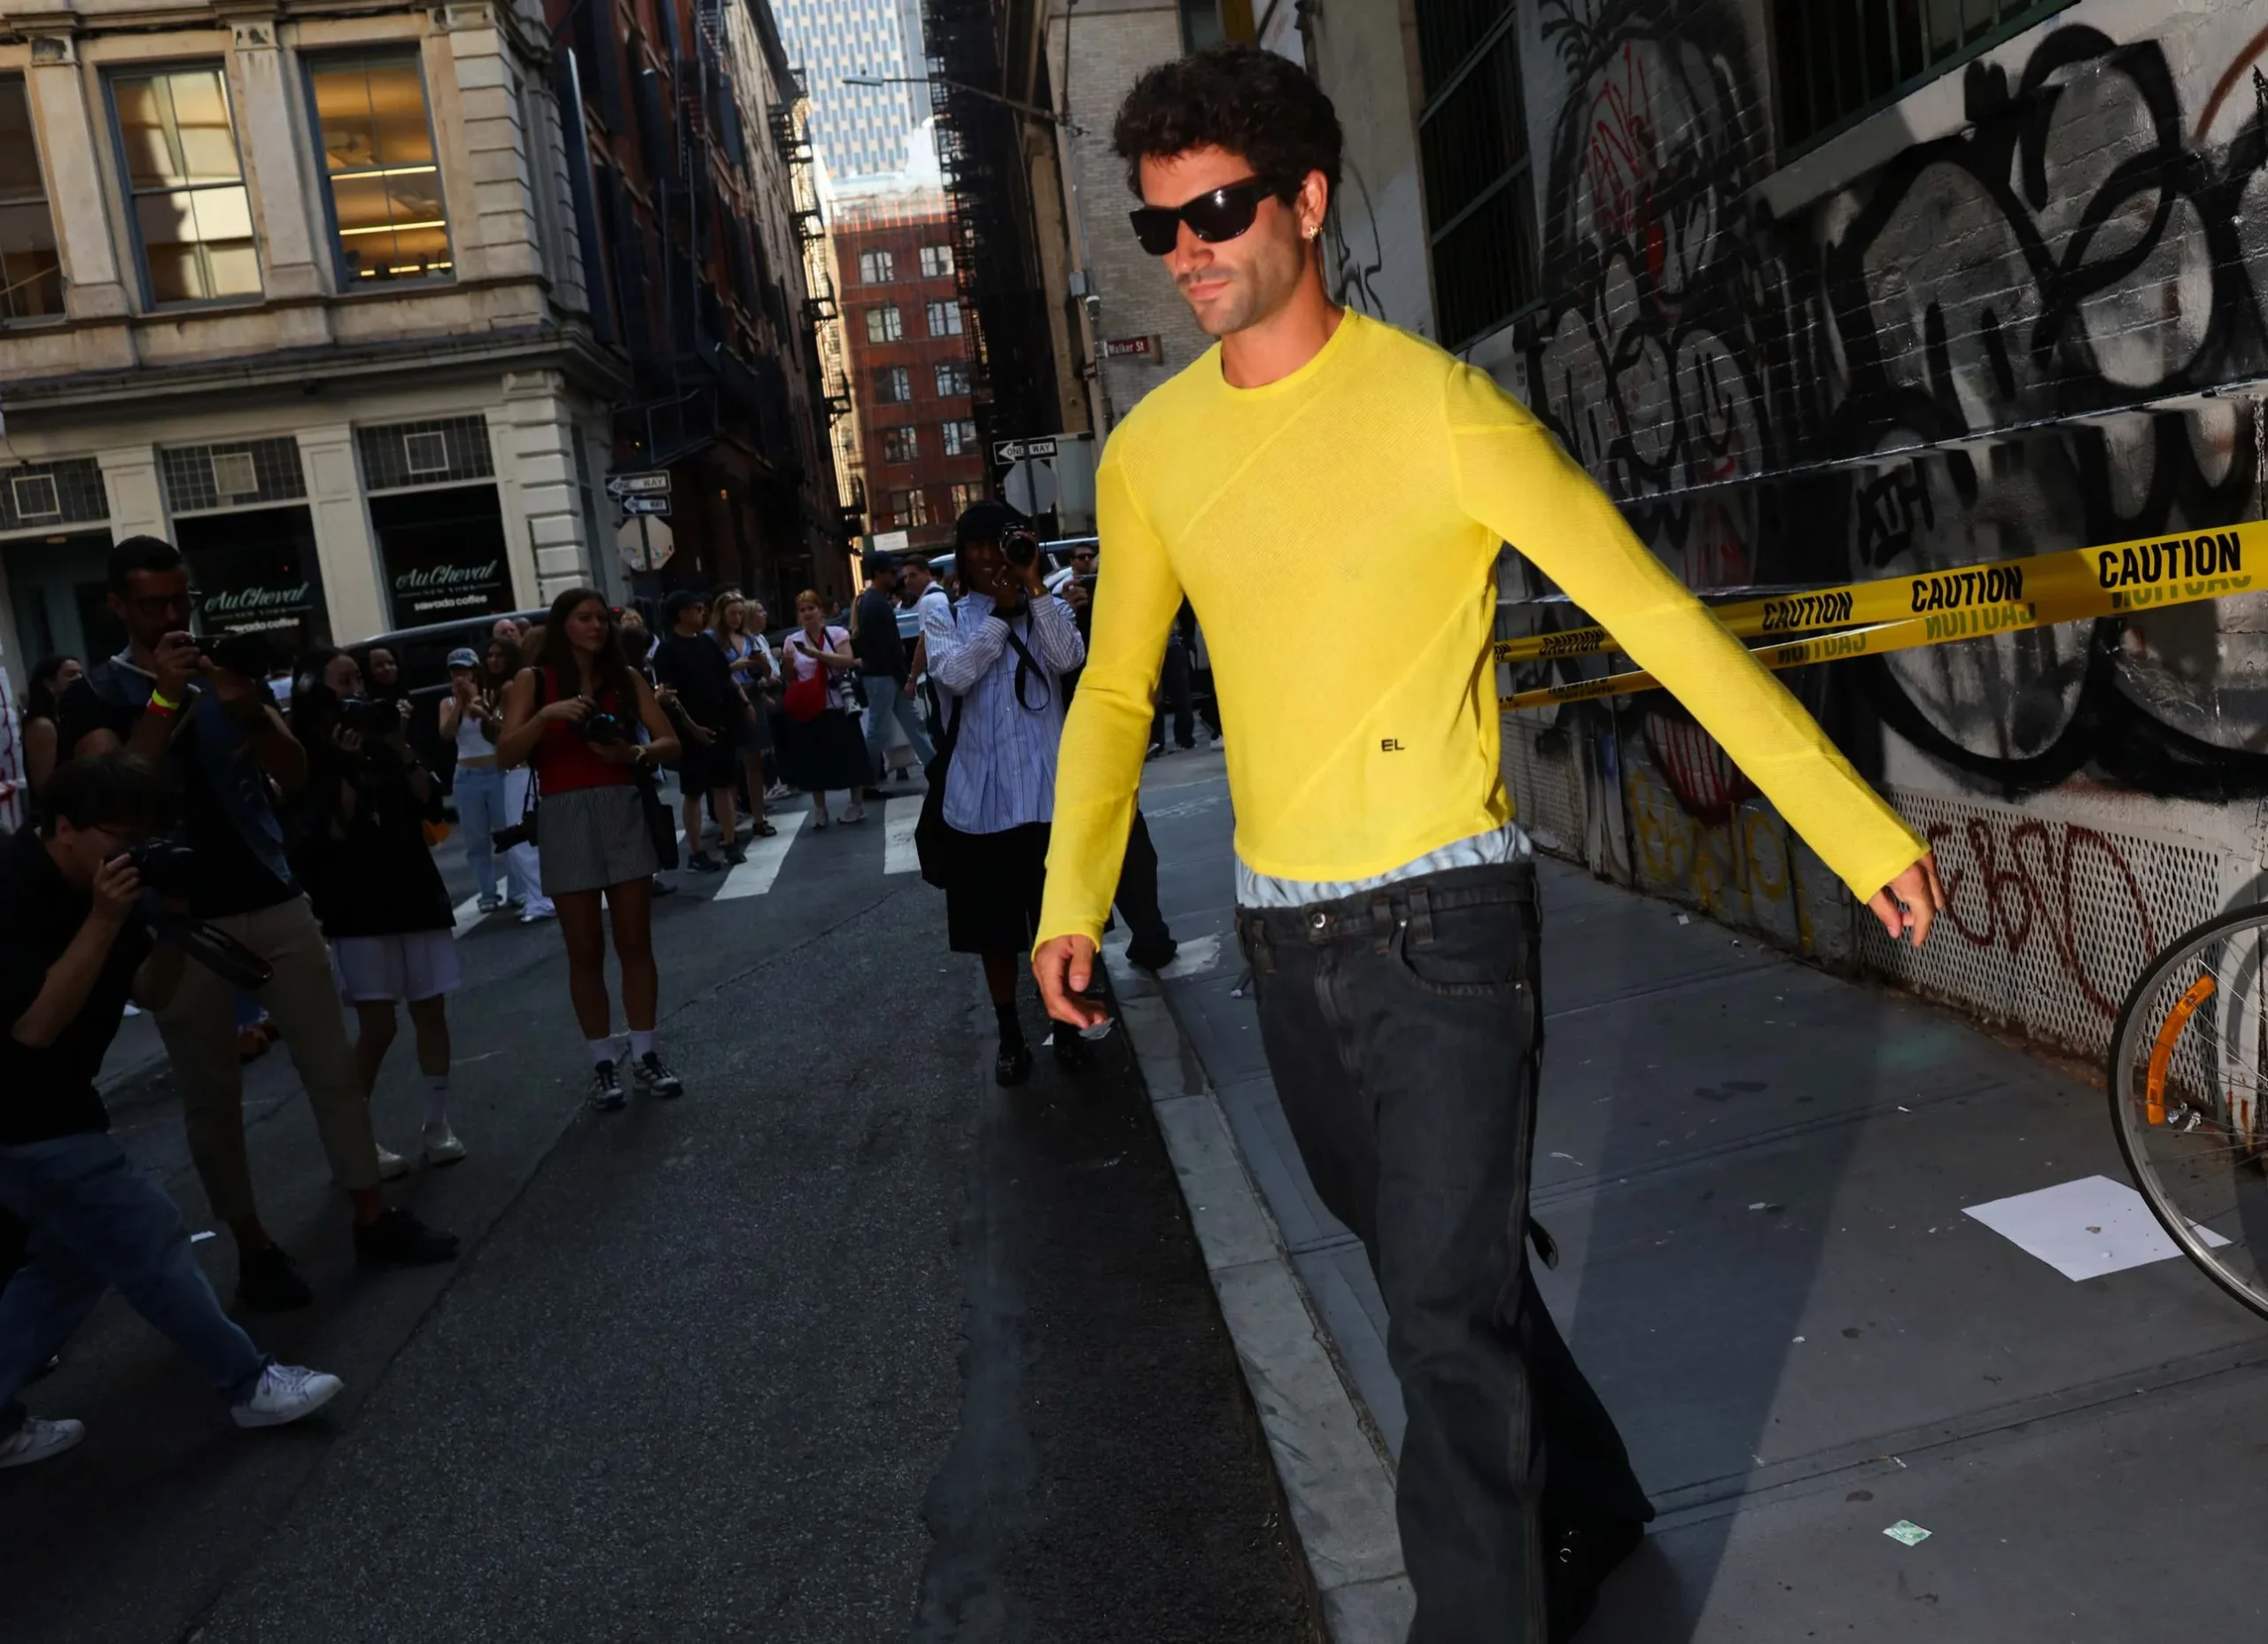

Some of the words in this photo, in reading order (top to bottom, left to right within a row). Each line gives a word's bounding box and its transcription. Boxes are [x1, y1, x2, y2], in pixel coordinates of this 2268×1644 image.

[1136, 340, 1145, 352] St
[1007, 446, 1024, 456] ONE
[1032, 444, 1050, 454] WAY
[642, 477, 663, 487] WAY
[2098, 531, 2241, 589] CAUTION
[1911, 565, 2023, 613] CAUTION
[455, 594, 488, 607] coffee
[1761, 591, 1853, 631] CAUTION
[1381, 738, 1405, 752] EL
